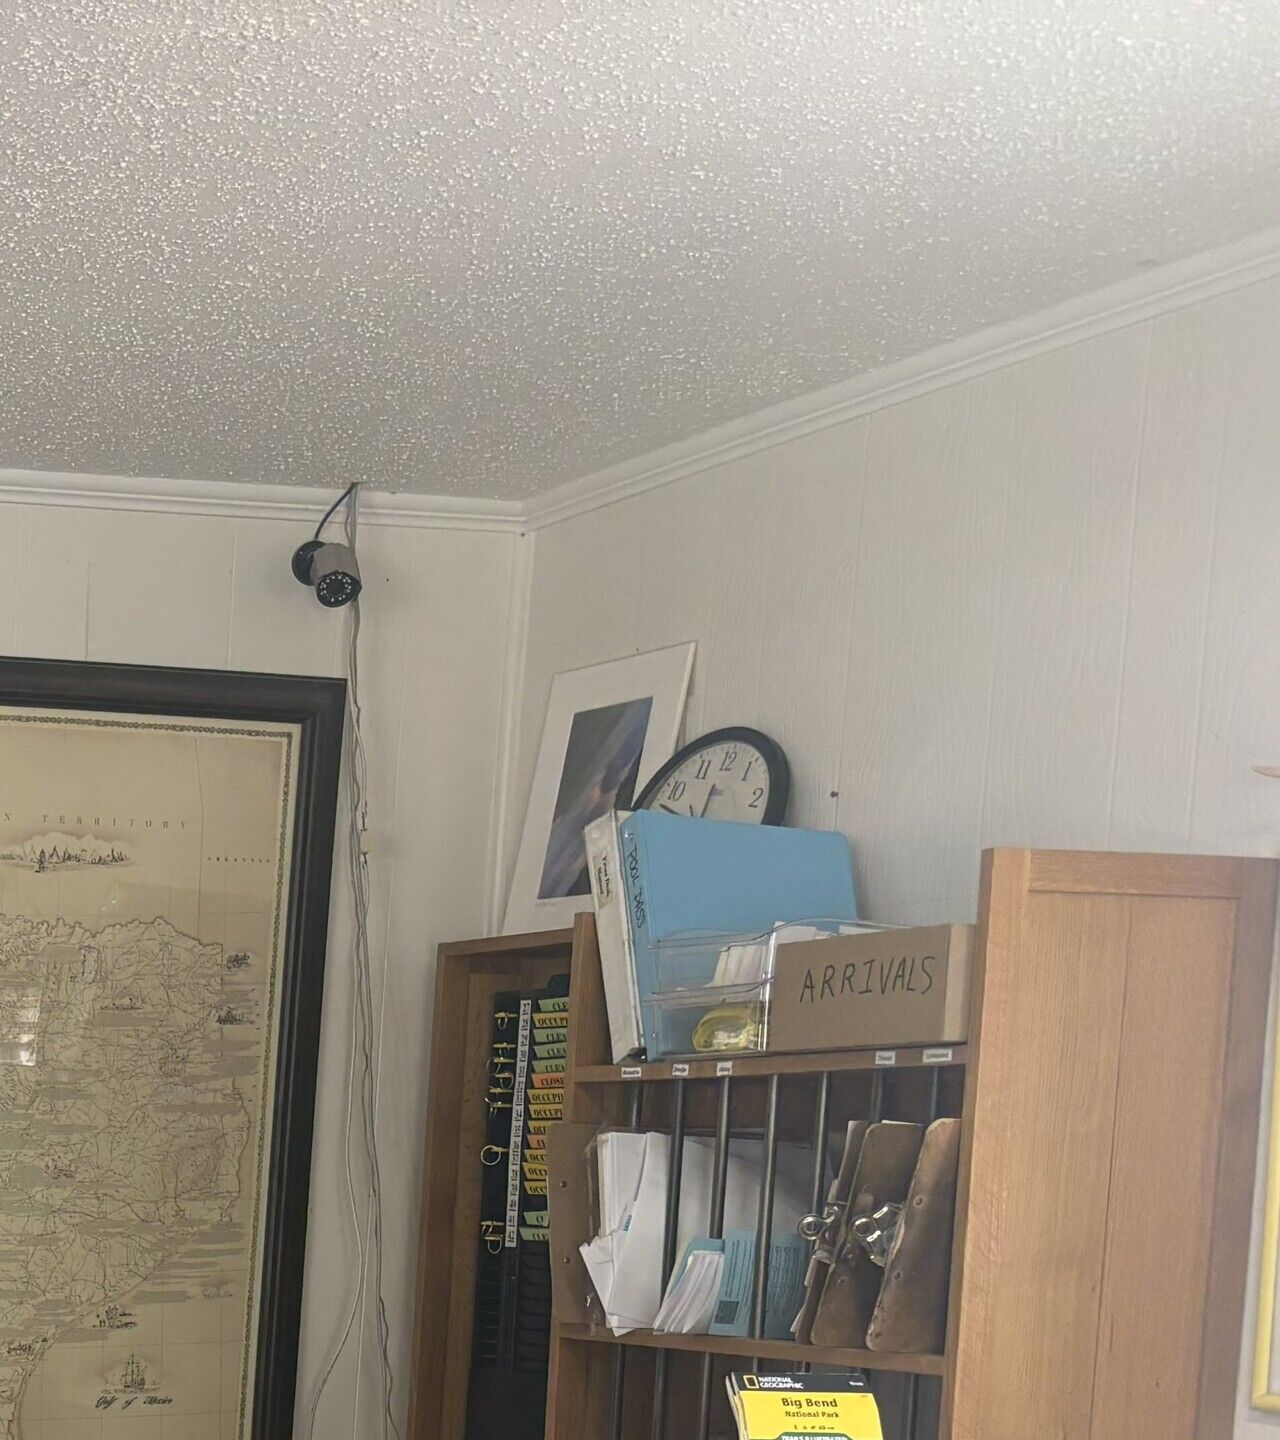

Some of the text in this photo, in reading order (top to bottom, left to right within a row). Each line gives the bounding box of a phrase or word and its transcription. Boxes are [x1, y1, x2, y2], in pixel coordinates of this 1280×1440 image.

[695, 759, 714, 780] 11
[718, 750, 738, 773] 12
[742, 759, 754, 782] 1
[748, 787, 764, 808] 2
[800, 956, 936, 1003] ARRIVALS
[782, 1397, 838, 1408] Big Bend
